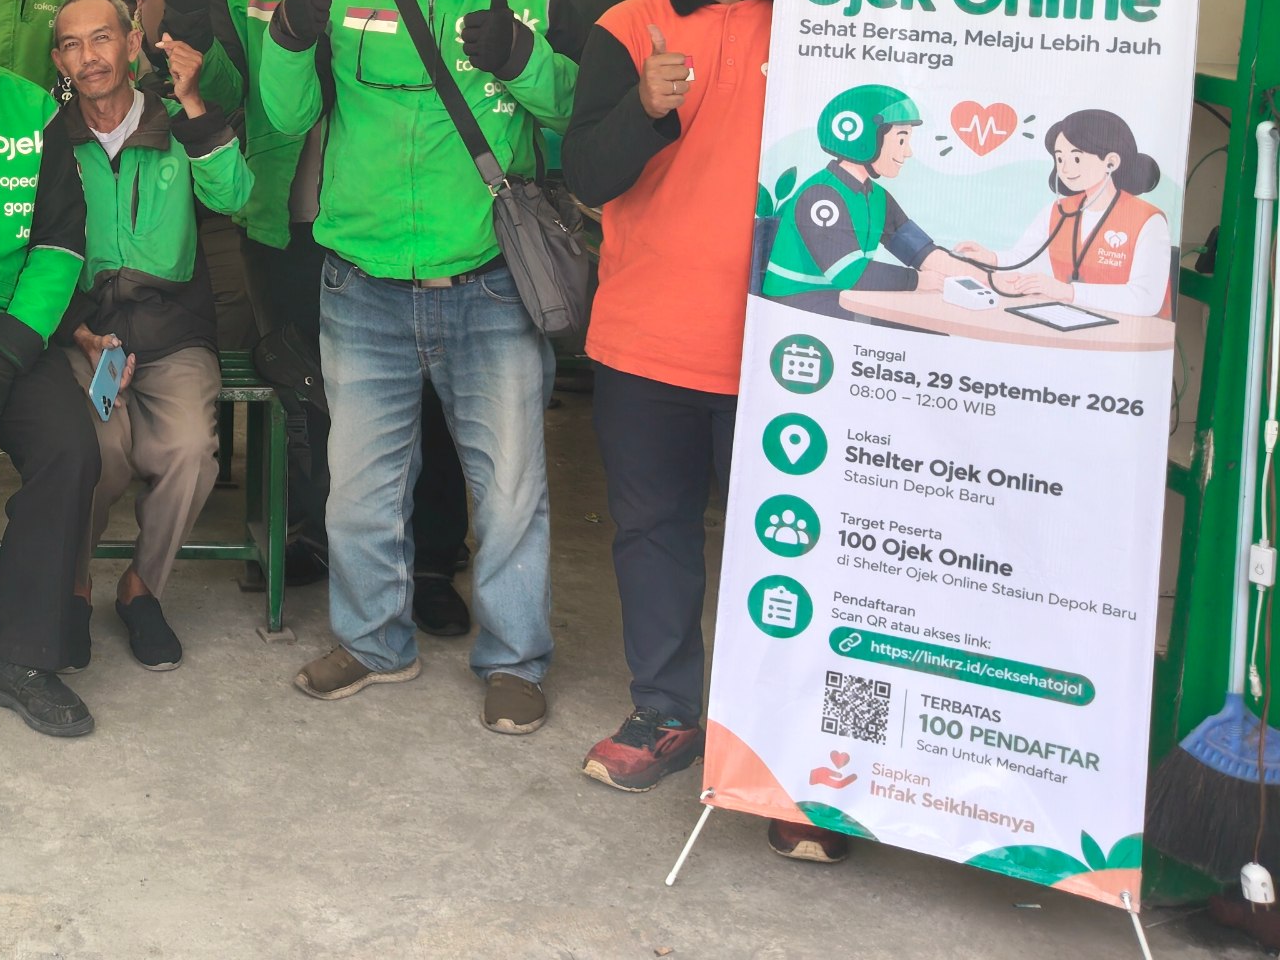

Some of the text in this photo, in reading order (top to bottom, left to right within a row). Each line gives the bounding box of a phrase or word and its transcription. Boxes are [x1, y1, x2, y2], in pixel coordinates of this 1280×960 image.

[799, 18, 1162, 56] Sehat Bersama, Melaju Lebih Jauh
[798, 43, 954, 69] untuk Keluarga
[1097, 248, 1127, 260] Rumah
[1098, 256, 1122, 267] Zakat
[853, 344, 906, 363] Tanggal
[849, 383, 897, 402] 08:00
[916, 393, 958, 412] 12:00
[963, 400, 997, 416] WIB
[851, 360, 1144, 417] Selasa, 29 September 2026
[847, 428, 891, 446] Lokasi
[843, 469, 995, 506] Stasiun Depok Baru
[844, 445, 1064, 496] Shelter Ojek Online
[840, 512, 942, 540] Target Peserta
[838, 529, 1013, 576] 100 Ojek Online
[833, 591, 916, 617] Pendaftaran
[836, 553, 1137, 621] di Shelter Ojek Online Stasiun Depok Baru
[831, 607, 991, 650] Scan QR atau akses link:
[870, 640, 1083, 697] https://linkrz.id/ceksehatojol
[921, 693, 1002, 723] TERBATAS
[918, 713, 1100, 772] 100 PENDAFTAR
[872, 762, 931, 787] Siapkan
[917, 739, 1068, 785] Scan Untuk Mendaftar
[870, 780, 1035, 833] Infak Seikhlasnya
